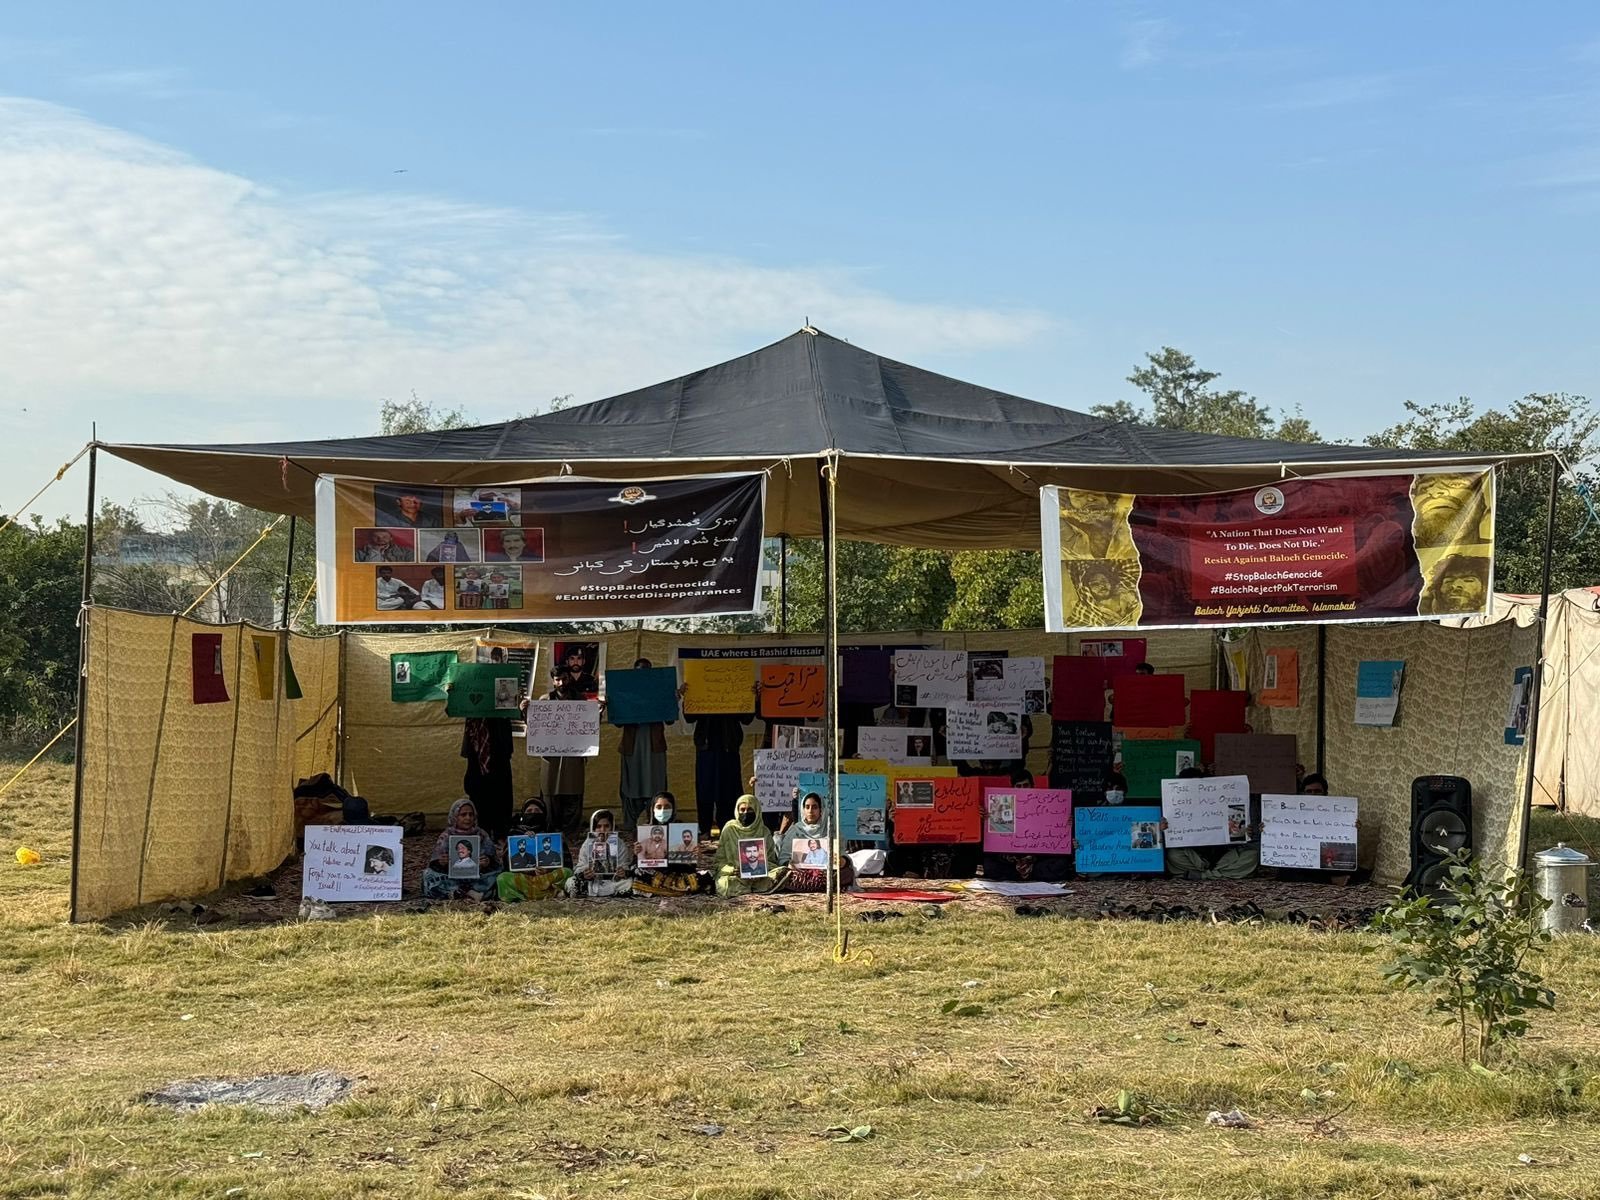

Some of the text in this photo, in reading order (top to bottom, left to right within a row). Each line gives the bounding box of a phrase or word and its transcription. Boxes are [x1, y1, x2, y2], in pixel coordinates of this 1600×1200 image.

[1219, 529, 1250, 538] Nation
[1251, 528, 1273, 537] That
[1275, 527, 1298, 536] Does
[1299, 526, 1317, 535] Not
[1318, 525, 1344, 534] Want
[1224, 543, 1237, 551] To
[1259, 541, 1282, 550] Does
[1284, 540, 1301, 549] Not
[1302, 539, 1325, 549] Die."
[630, 557, 698, 574] بلوچستان
[1204, 552, 1349, 566] Resist Against Baloch Genocide.
[1224, 569, 1323, 583] #StopBalochGenocide
[580, 579, 717, 594] #StopBalochGenocide
[1210, 583, 1338, 596] #BalochRejectPakTerrorism
[554, 587, 743, 602] #EndEnforcedDisappearances
[1194, 606, 1225, 616] Baloch
[1226, 604, 1262, 618] Yakjehti
[1312, 601, 1357, 613] Islamabad
[701, 649, 720, 658] UAE
[721, 649, 749, 657] where
[751, 649, 758, 657] is
[760, 647, 789, 656] Rashid
[309, 840, 361, 855] You talk about
